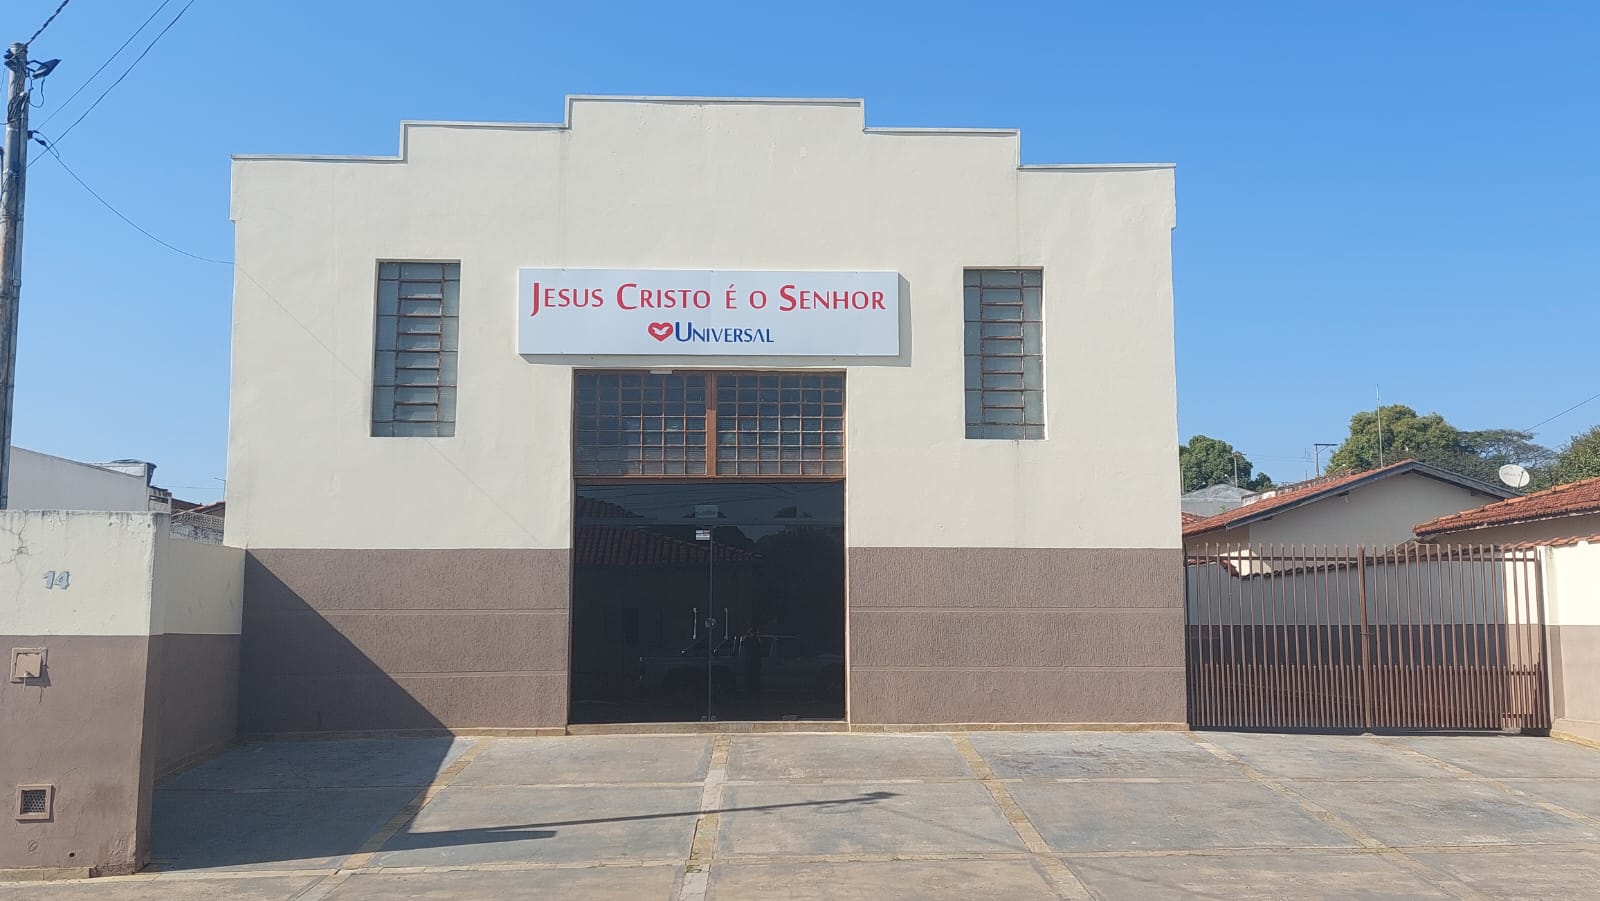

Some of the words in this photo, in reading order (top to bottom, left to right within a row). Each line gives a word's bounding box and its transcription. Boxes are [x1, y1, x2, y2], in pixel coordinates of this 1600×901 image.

[530, 282, 604, 317] JESUS
[616, 283, 711, 311] CRISTO
[725, 284, 737, 310] É
[748, 290, 768, 310] O
[779, 284, 886, 312] SENHOR
[675, 321, 775, 343] UNIVERSAL
[43, 570, 70, 590] 14
